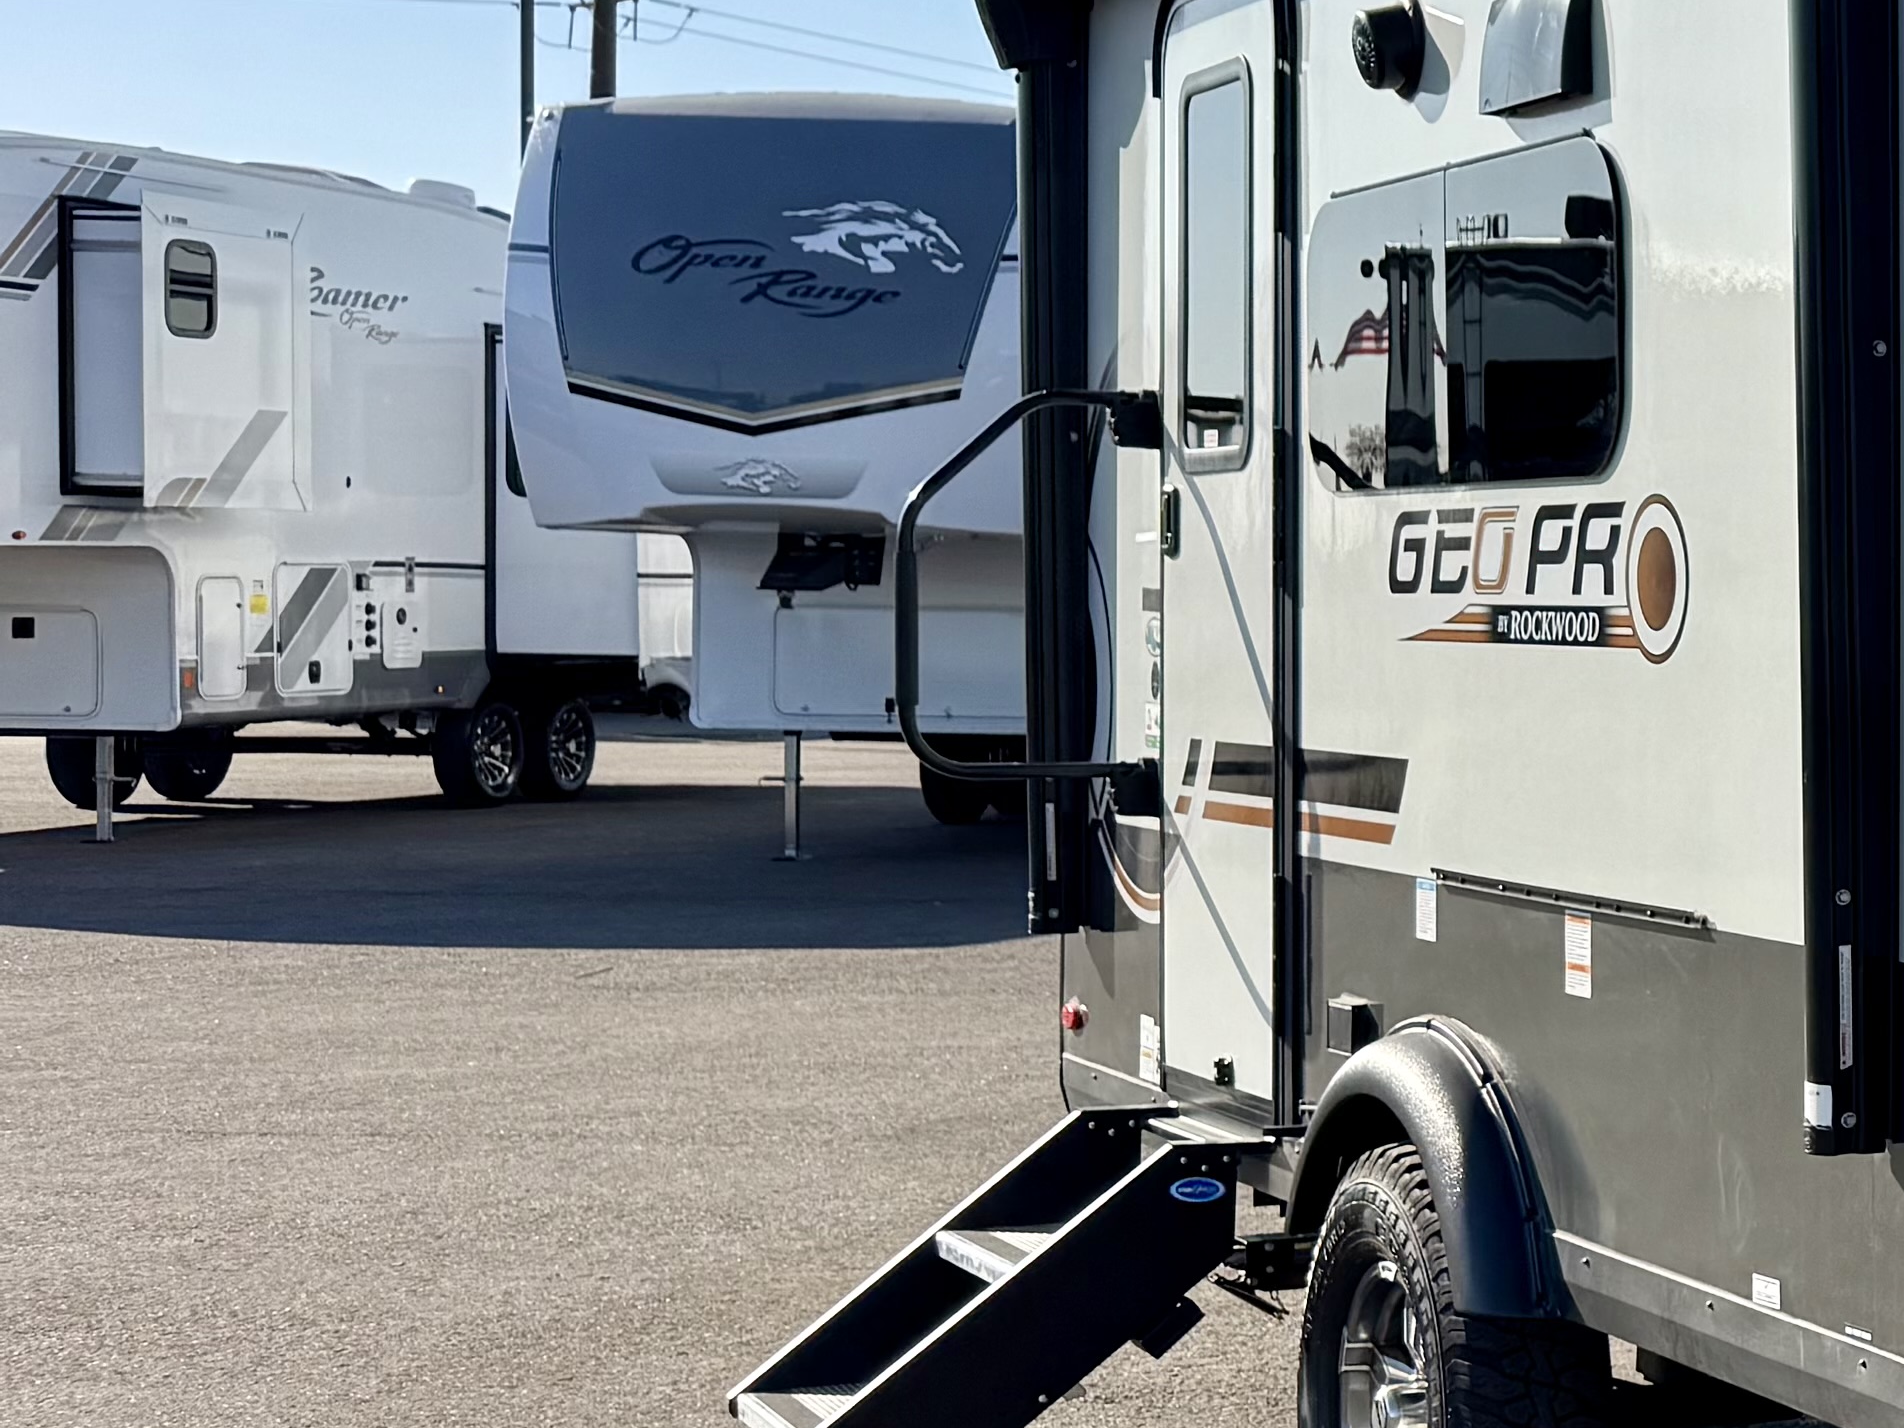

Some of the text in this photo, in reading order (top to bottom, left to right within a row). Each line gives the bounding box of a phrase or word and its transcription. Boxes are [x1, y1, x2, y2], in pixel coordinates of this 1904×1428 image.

[631, 234, 776, 285] Open
[728, 269, 902, 319] Range
[1388, 505, 1520, 595] GEO
[1497, 609, 1600, 642] BY ROCKWOOD
